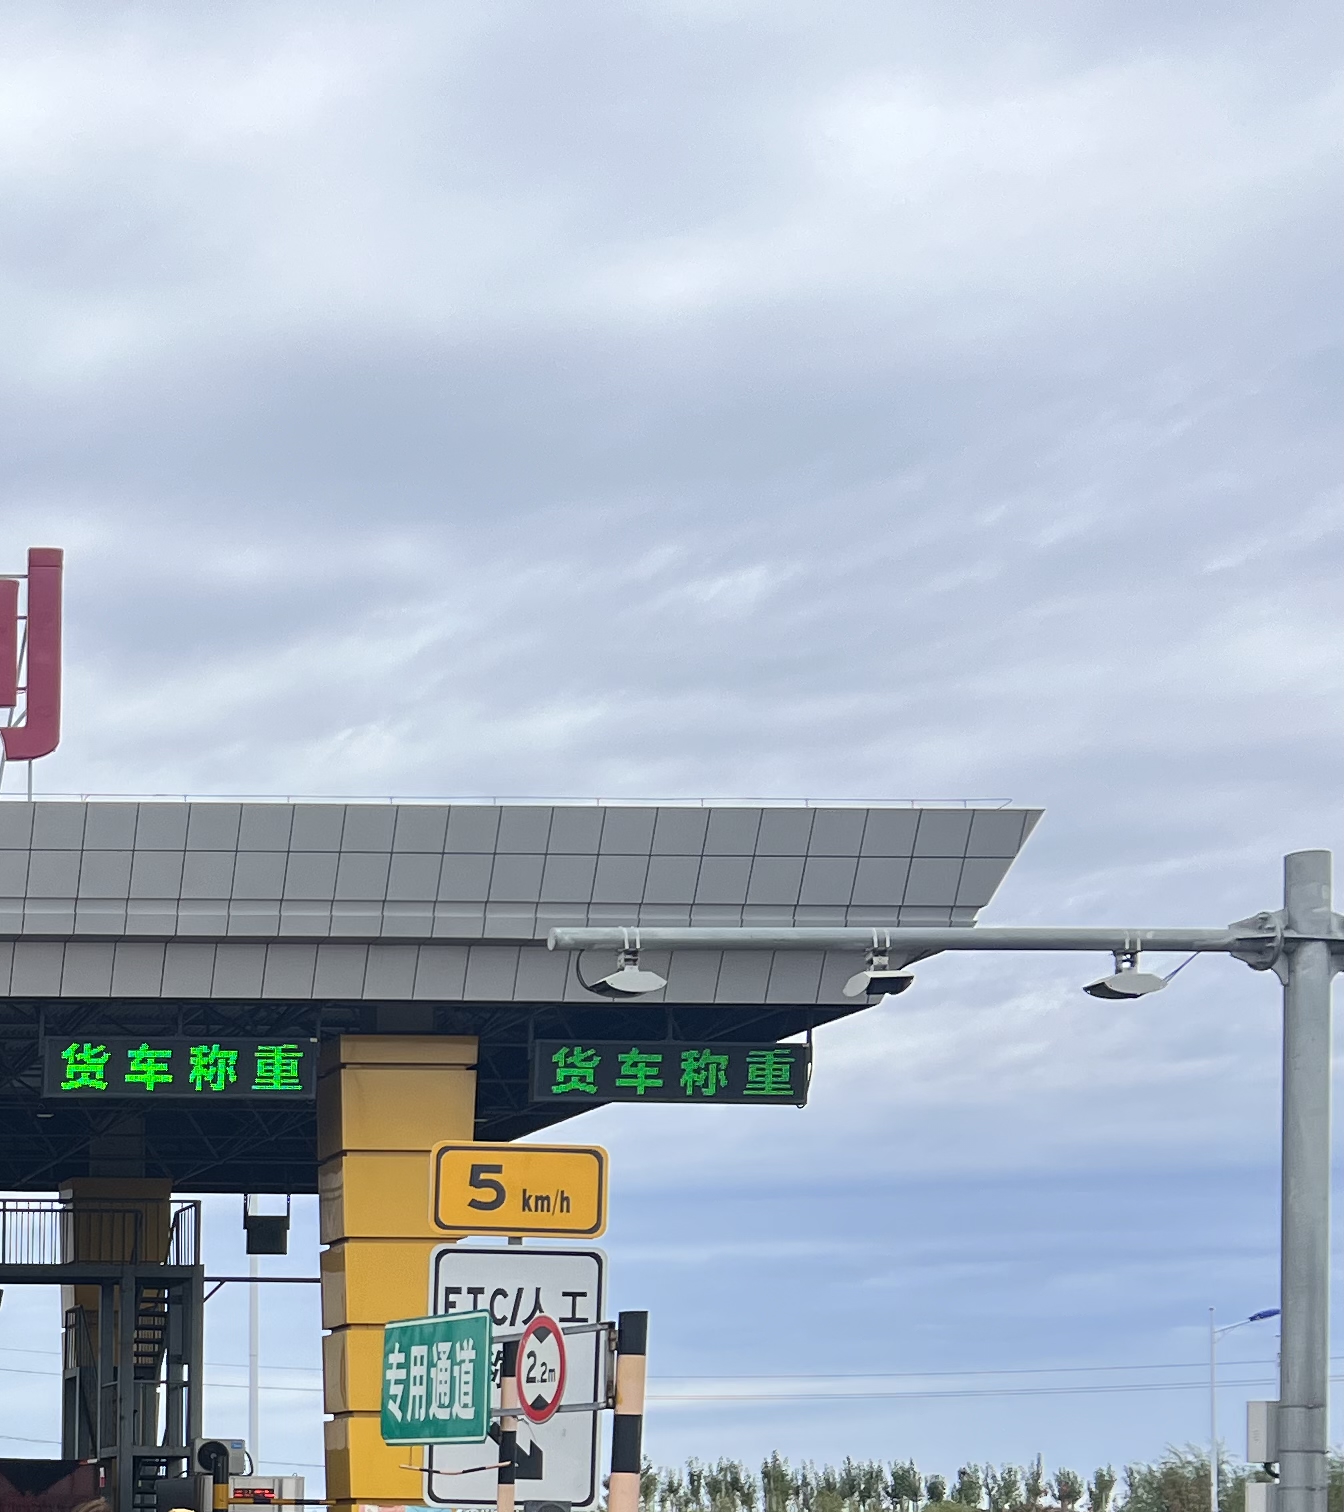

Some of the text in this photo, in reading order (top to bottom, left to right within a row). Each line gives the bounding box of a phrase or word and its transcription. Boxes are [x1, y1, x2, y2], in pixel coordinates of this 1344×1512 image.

[59, 1042, 303, 1092] 货车称重
[549, 1046, 796, 1097] 货车称重
[466, 1163, 572, 1216] 5 km/h
[385, 1337, 477, 1424] 专用通道
